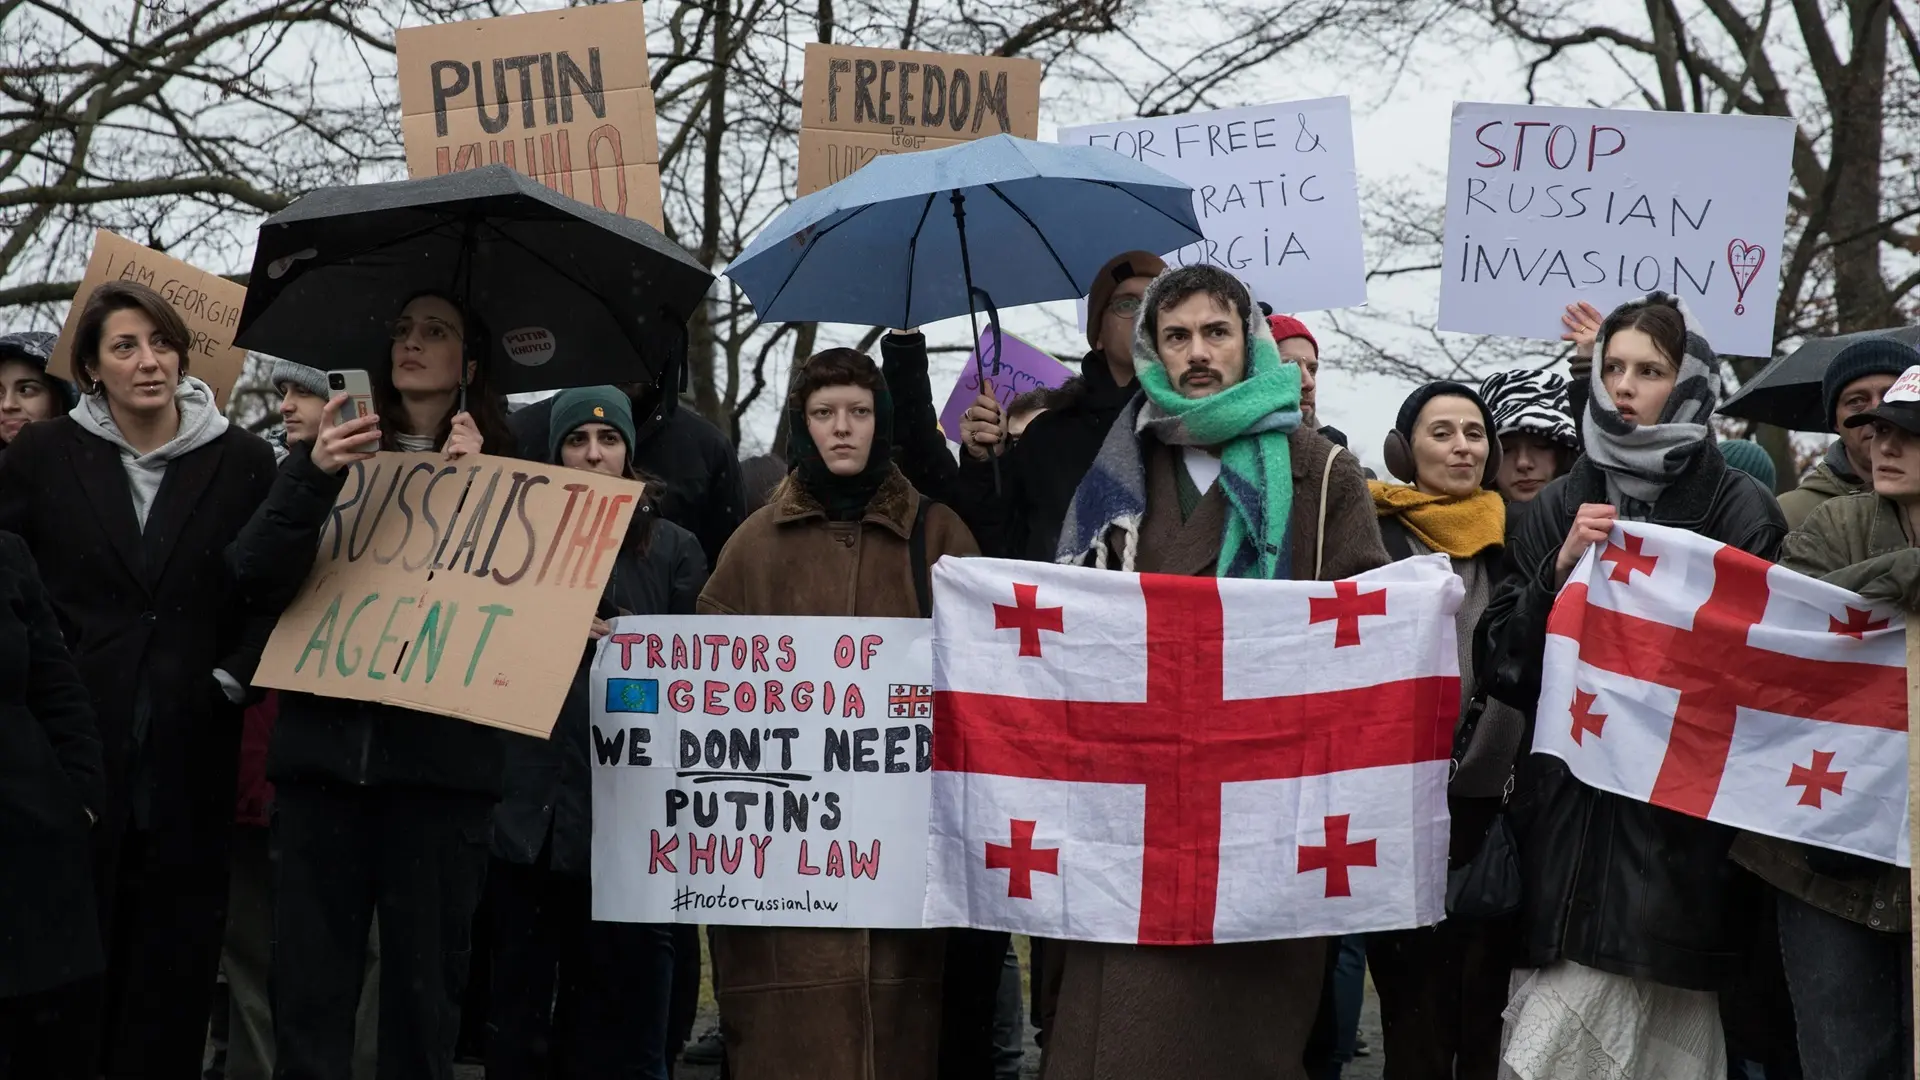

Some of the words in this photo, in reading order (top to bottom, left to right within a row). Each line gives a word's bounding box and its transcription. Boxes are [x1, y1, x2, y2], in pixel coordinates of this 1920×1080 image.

[430, 46, 606, 137] PUTIN
[828, 57, 1012, 134] FREEDOM
[1175, 118, 1277, 158] FREE
[1294, 112, 1327, 153] &
[1475, 120, 1626, 172] STOP
[1465, 177, 1712, 237] RUSSIAN
[105, 253, 114, 276] I
[119, 260, 155, 288] AM
[505, 329, 548, 344] PUTIN
[511, 341, 552, 357] KHUYLO
[533, 482, 633, 590] THE
[293, 591, 514, 688] AGENT
[610, 633, 797, 673] TRAITORS
[833, 634, 884, 670] OF
[667, 679, 866, 719] GEORGIA
[591, 724, 653, 767] WE
[679, 726, 800, 772] DON'T
[823, 724, 933, 774] NEED
[665, 788, 842, 833] PUTIN'S
[648, 829, 773, 879] KHUY
[797, 838, 882, 881] LAW
[670, 884, 840, 912] #notorussianlaw
